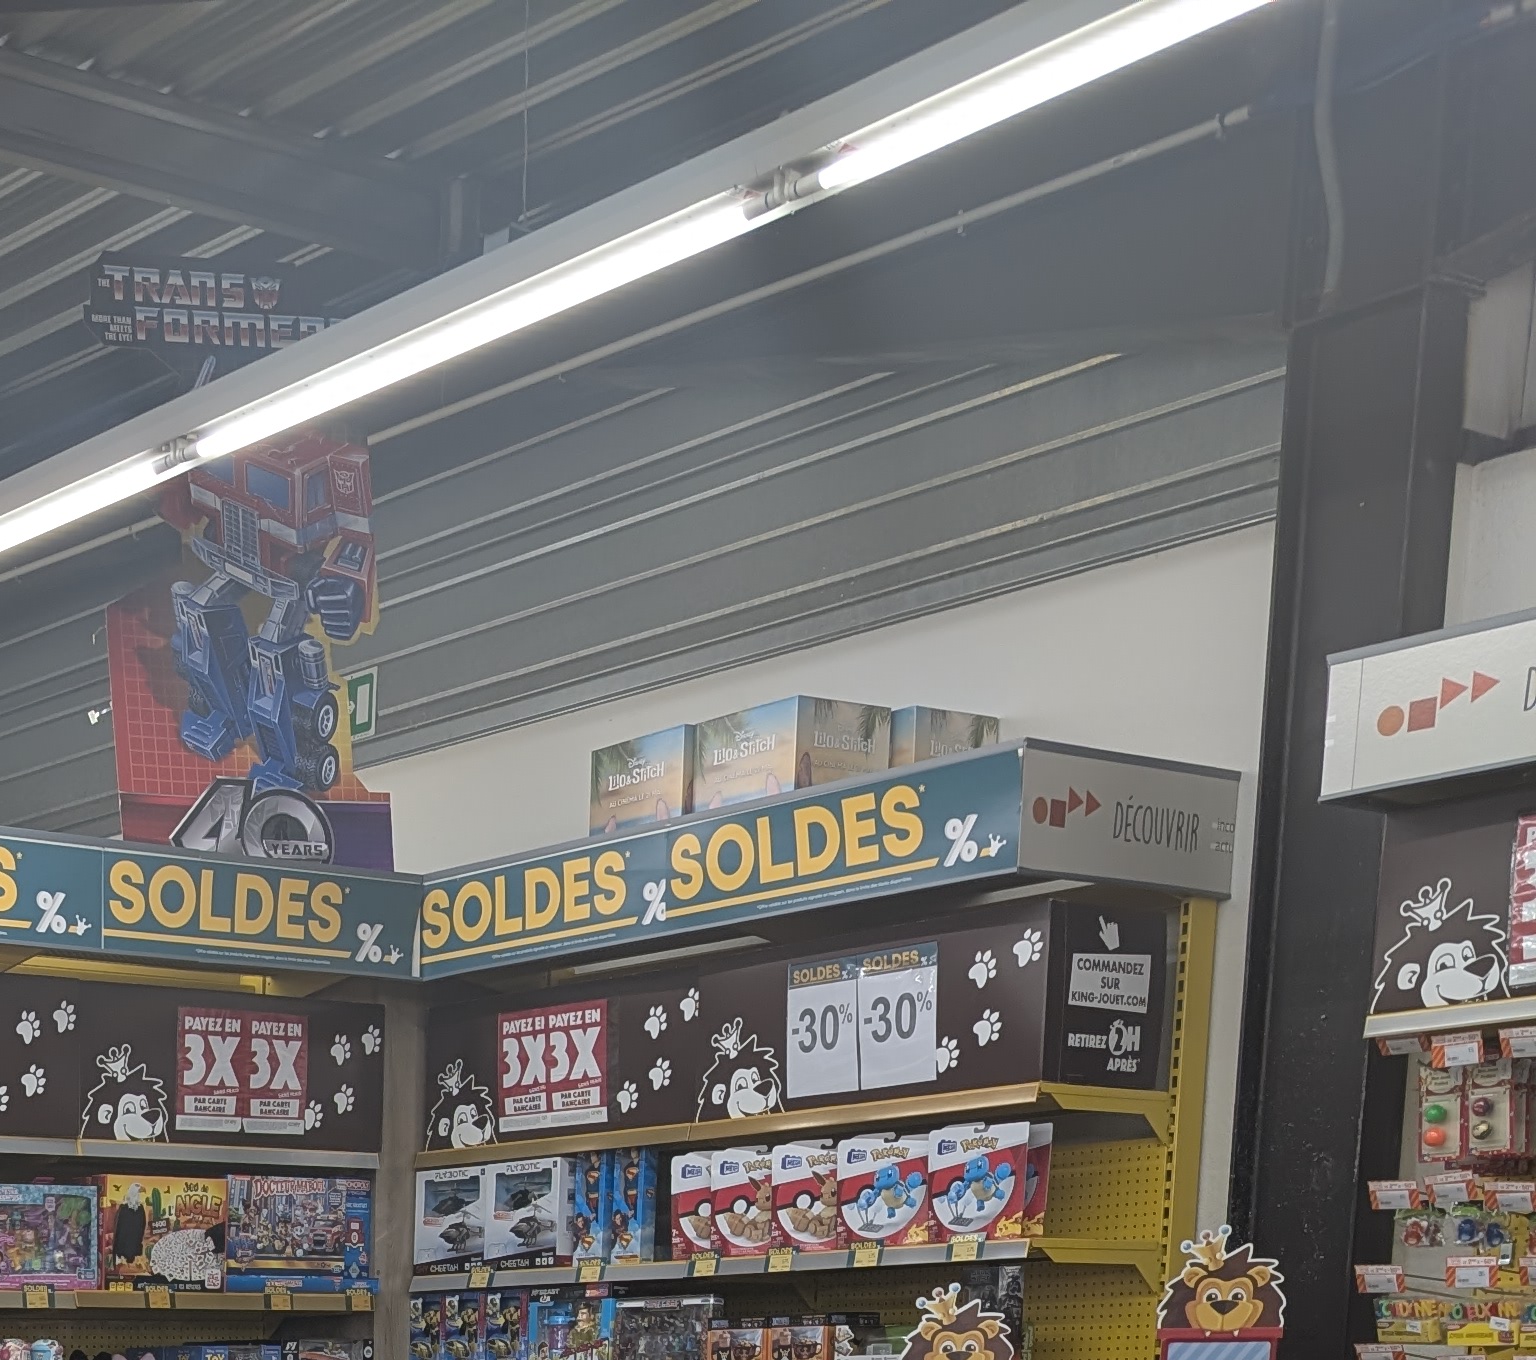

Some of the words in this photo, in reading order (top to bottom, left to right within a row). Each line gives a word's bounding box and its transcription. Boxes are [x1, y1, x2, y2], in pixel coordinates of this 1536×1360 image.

[103, 264, 244, 308] TRANS
[134, 306, 343, 348] FORMER
[1113, 796, 1200, 853] DÉCOUVRIR
[271, 841, 324, 858] YEARS
[793, 964, 840, 984] SOLDES
[1077, 959, 1144, 976] COMMANDEZ
[1100, 977, 1120, 991] SUR
[1071, 991, 1147, 1007] KING-JOUET.COM
[792, 1003, 852, 1053] -30%
[864, 991, 932, 1043] -30%
[1068, 1022, 1106, 1048] RETIREZ
[175, 1195, 223, 1218] AIGLE
